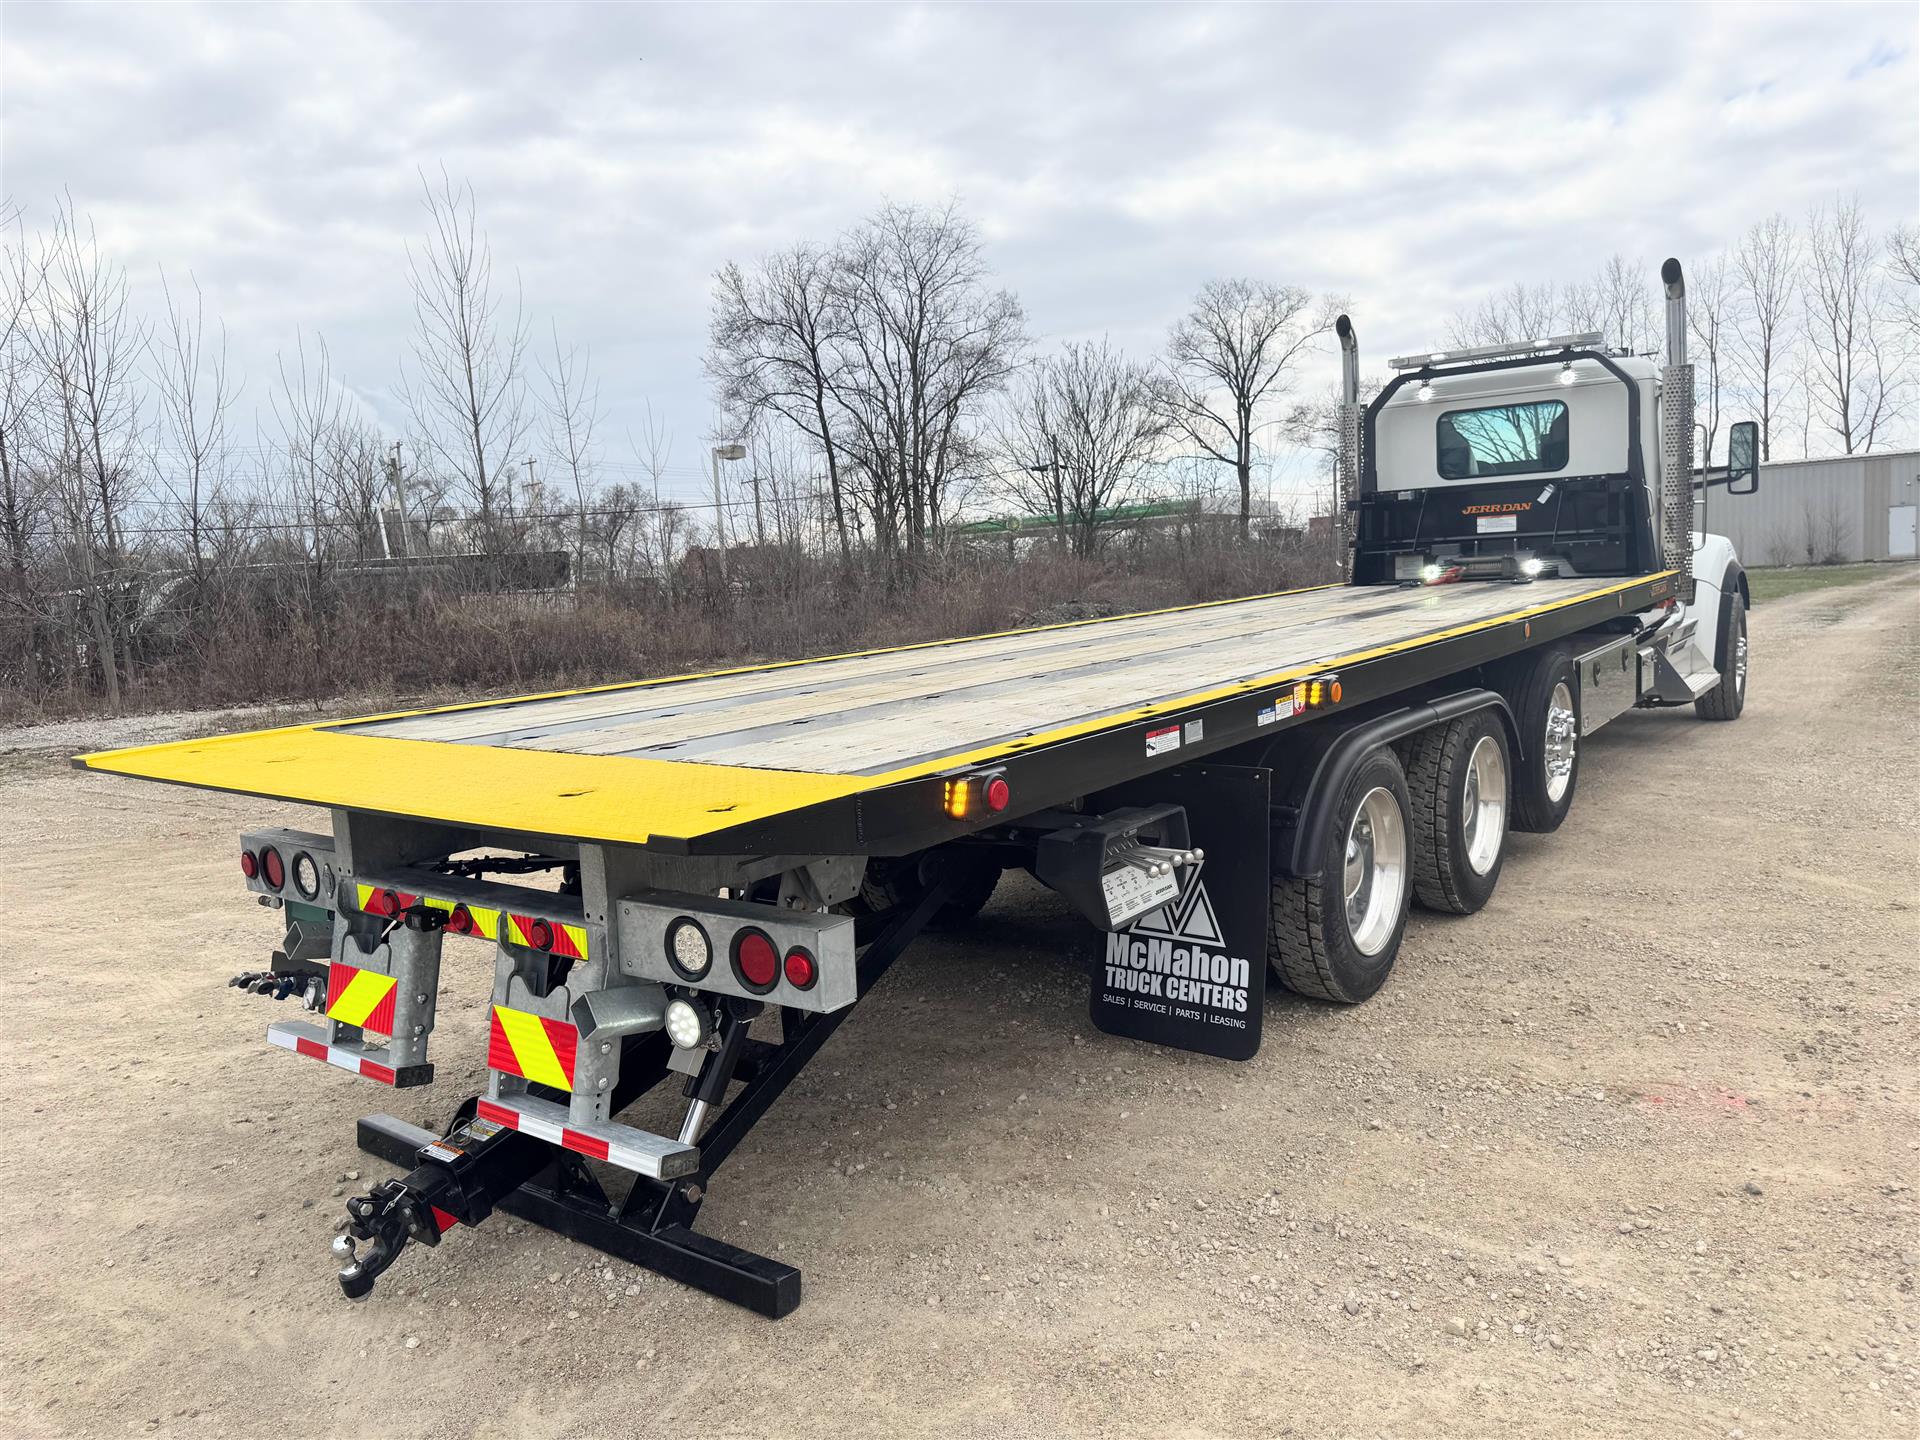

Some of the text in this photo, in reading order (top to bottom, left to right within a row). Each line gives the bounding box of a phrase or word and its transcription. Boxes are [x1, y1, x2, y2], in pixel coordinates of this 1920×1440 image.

[1106, 932, 1249, 988] McMahon
[1103, 994, 1246, 1029] SALES SERVICE PARTS LEASING
[1105, 965, 1248, 1012] TRUCK CENTERS
